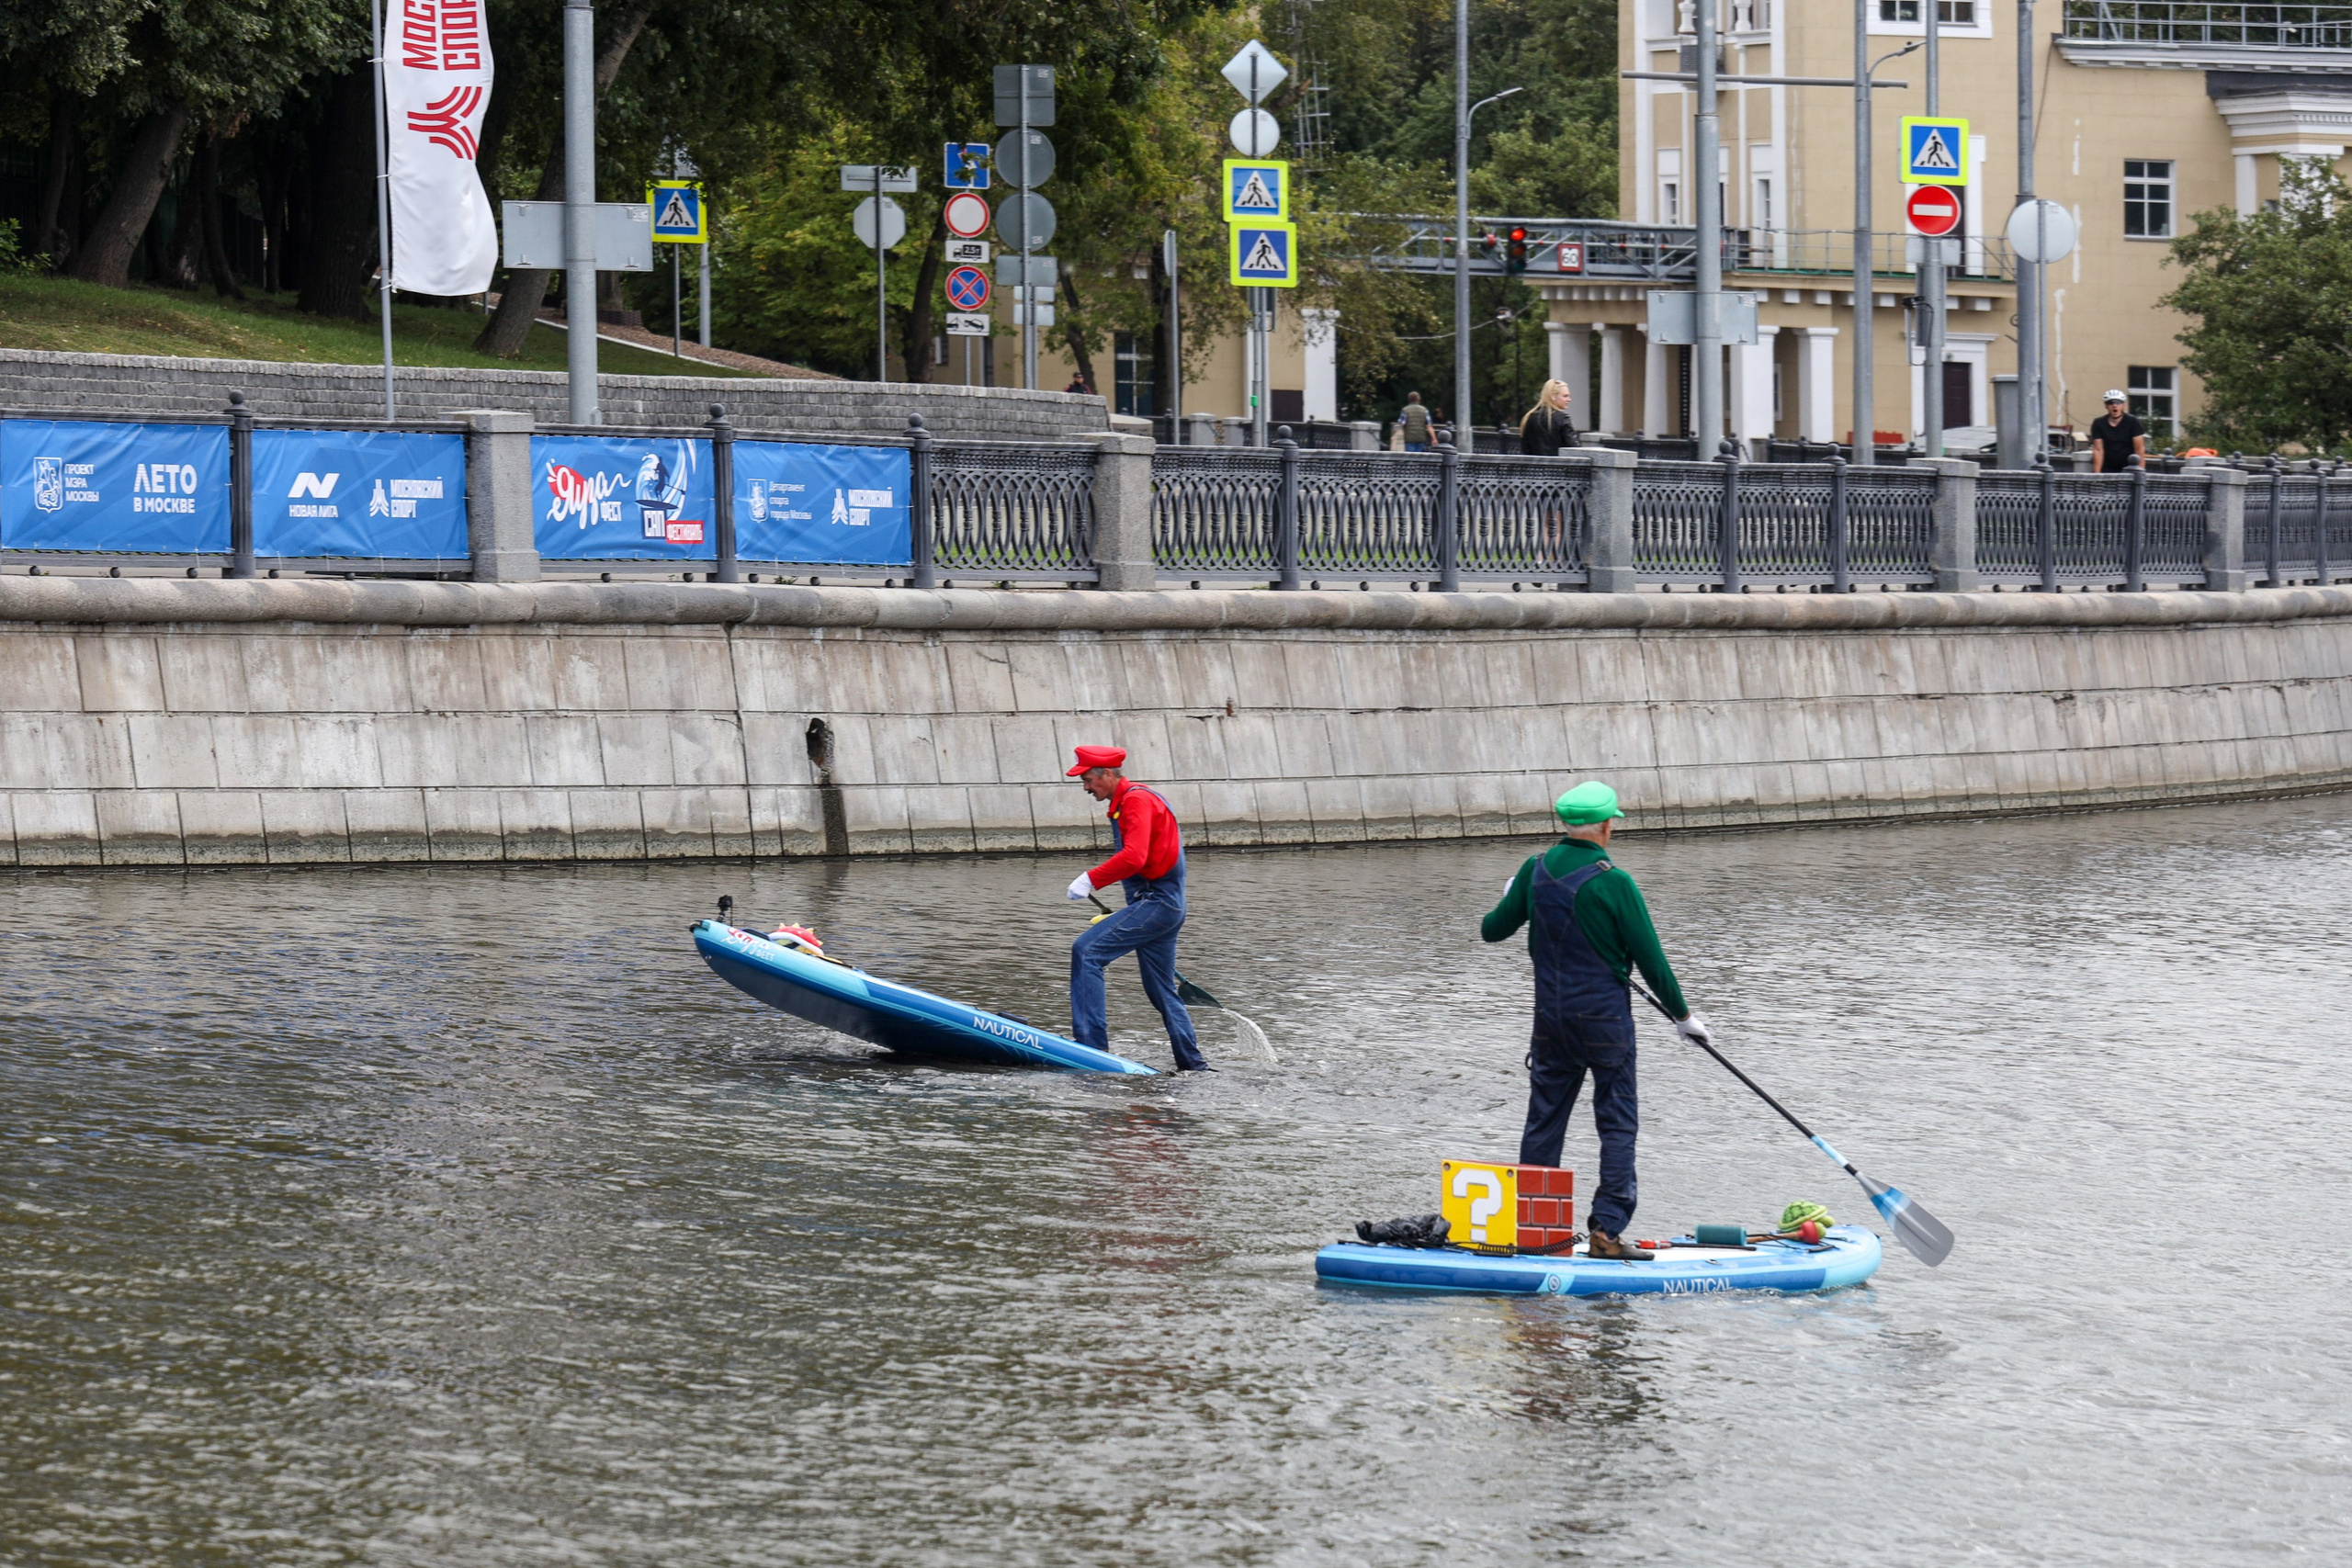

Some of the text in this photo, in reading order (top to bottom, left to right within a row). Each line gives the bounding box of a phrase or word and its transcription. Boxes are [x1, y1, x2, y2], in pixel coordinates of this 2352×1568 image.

[402, 0, 438, 70] МОС
[1563, 253, 1578, 264] 60
[64, 464, 95, 475] ПРОЕКТ
[65, 478, 88, 489] МЭРА
[133, 463, 198, 494] ЛЕТО
[390, 477, 444, 499] МОСКОВСКИЙ
[769, 481, 806, 493] Департамент
[65, 491, 100, 502] МОСКВЫ
[133, 497, 196, 513] В МОСКВЕ
[289, 504, 339, 518] НОВАЯ ЛИГА
[390, 500, 417, 518] СПОРТ
[600, 501, 622, 522] ФЕСТ
[643, 510, 666, 537] САП
[666, 524, 703, 541] ФЕСТИВАЛЬ
[974, 1016, 1044, 1050] NAUTICAL
[1663, 1277, 1733, 1293] NAUTICAL
